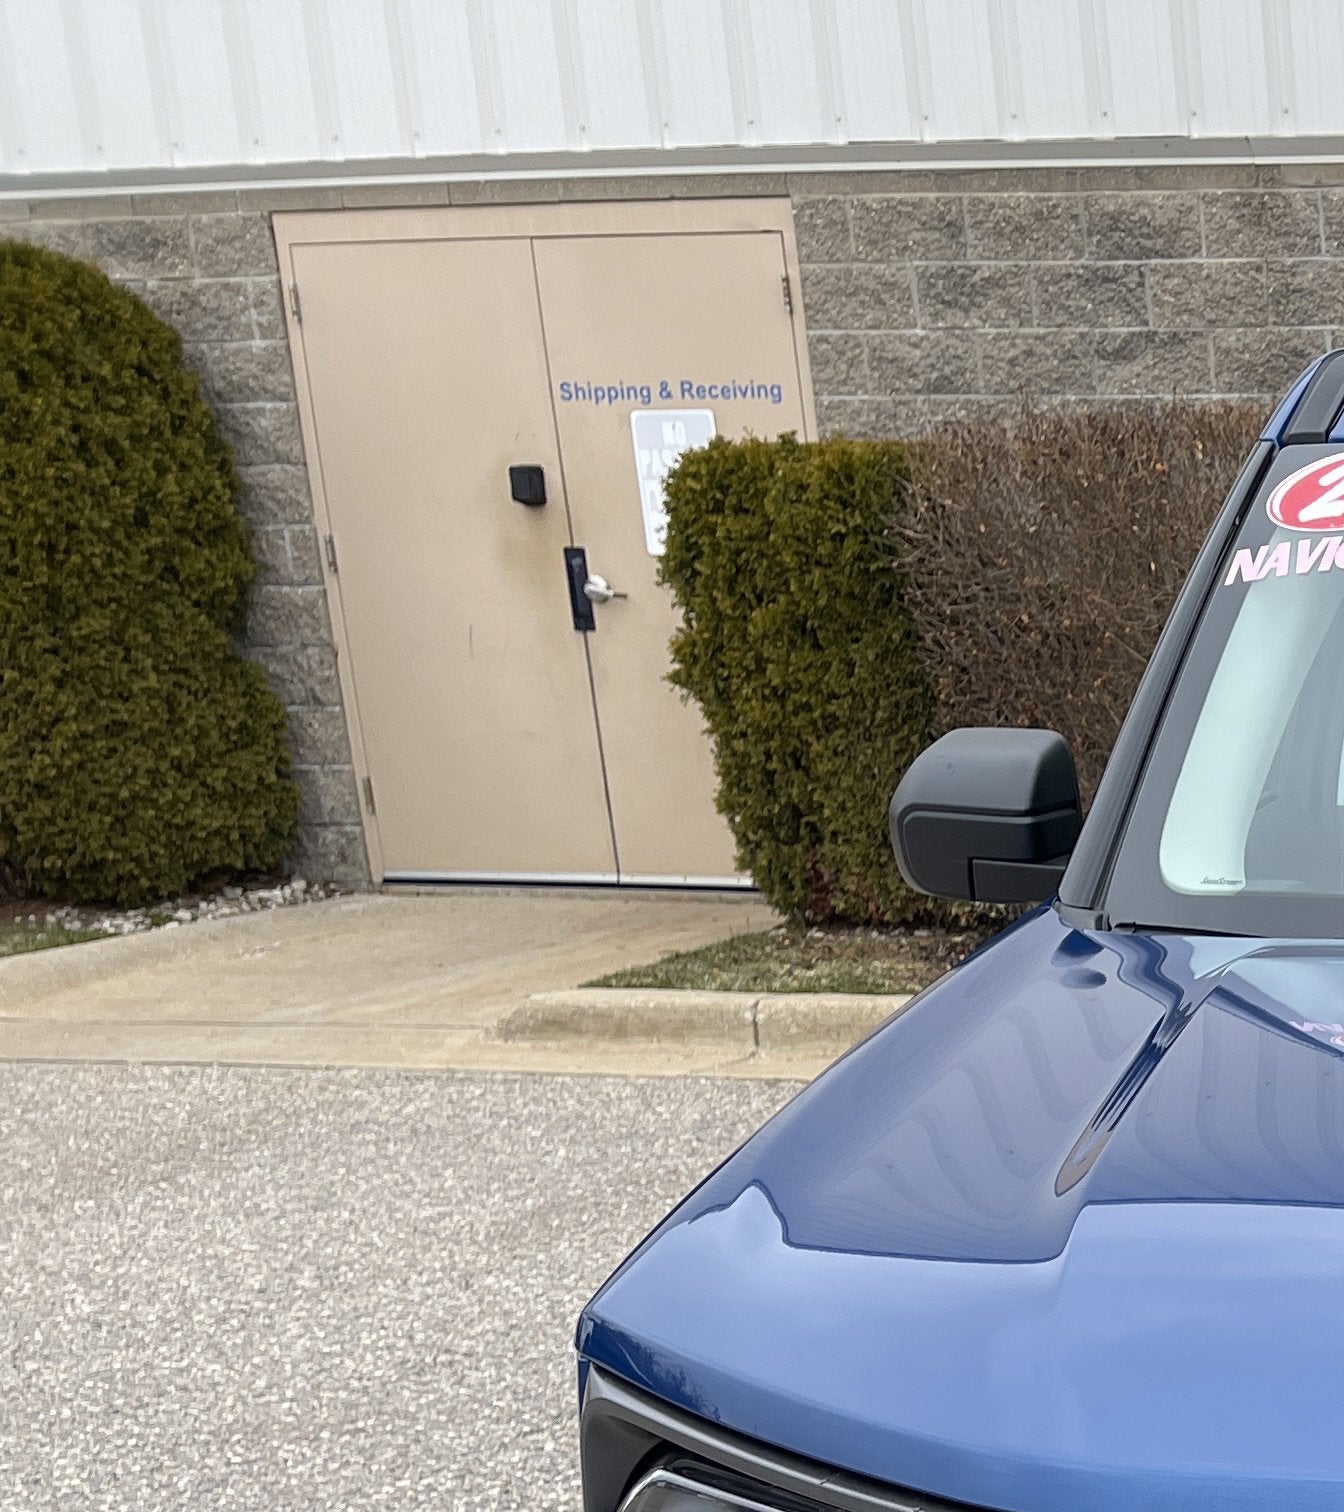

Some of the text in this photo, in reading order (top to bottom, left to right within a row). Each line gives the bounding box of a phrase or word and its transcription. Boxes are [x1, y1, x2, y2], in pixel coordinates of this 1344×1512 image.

[559, 379, 783, 405] Shipping & Receiving
[662, 420, 687, 446] NO
